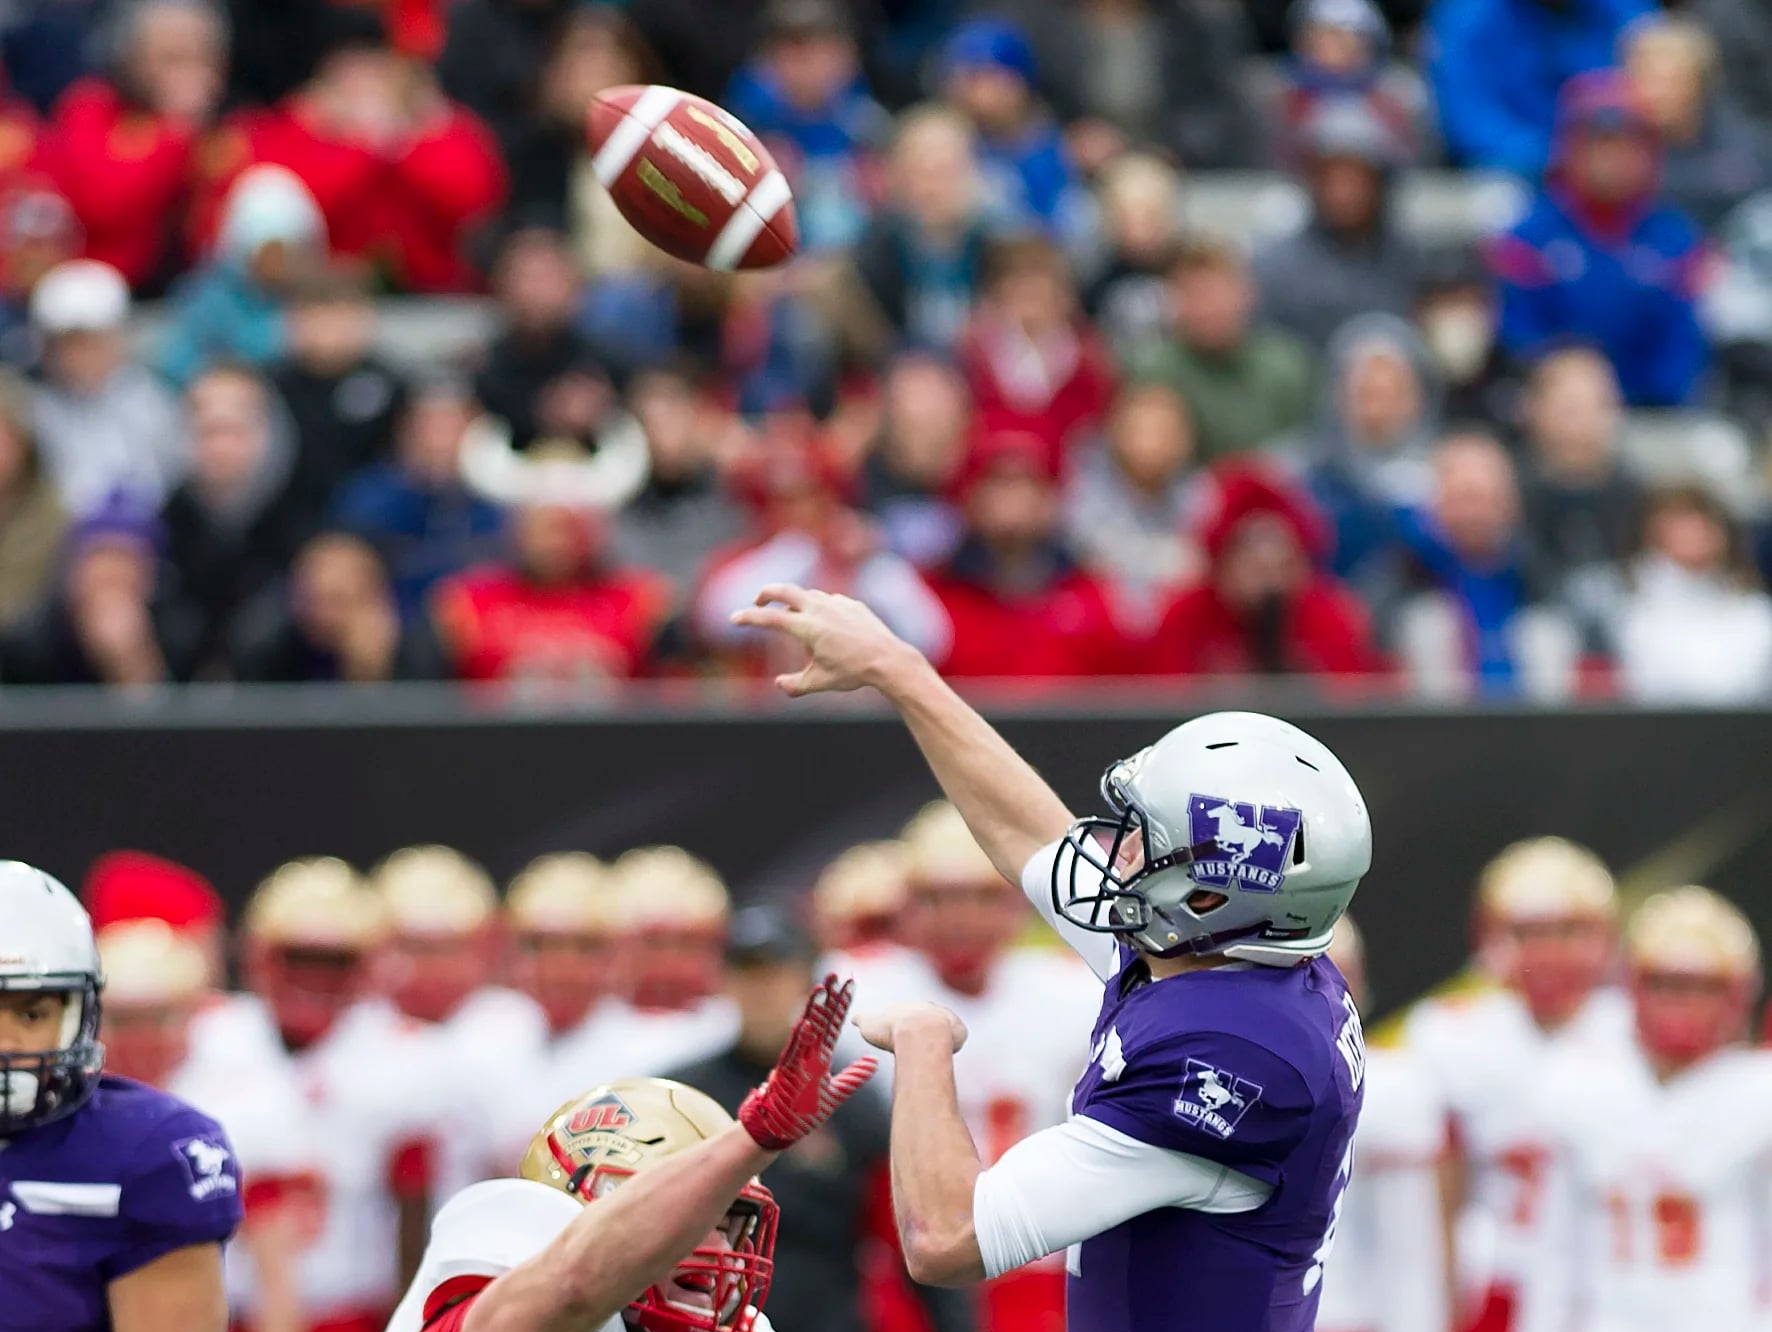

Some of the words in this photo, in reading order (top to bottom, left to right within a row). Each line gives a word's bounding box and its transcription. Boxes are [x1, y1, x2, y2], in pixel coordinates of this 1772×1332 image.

[1193, 862, 1280, 887] MUSTANGS
[568, 1103, 628, 1133] UL
[1174, 1100, 1235, 1137] MUSTANGS
